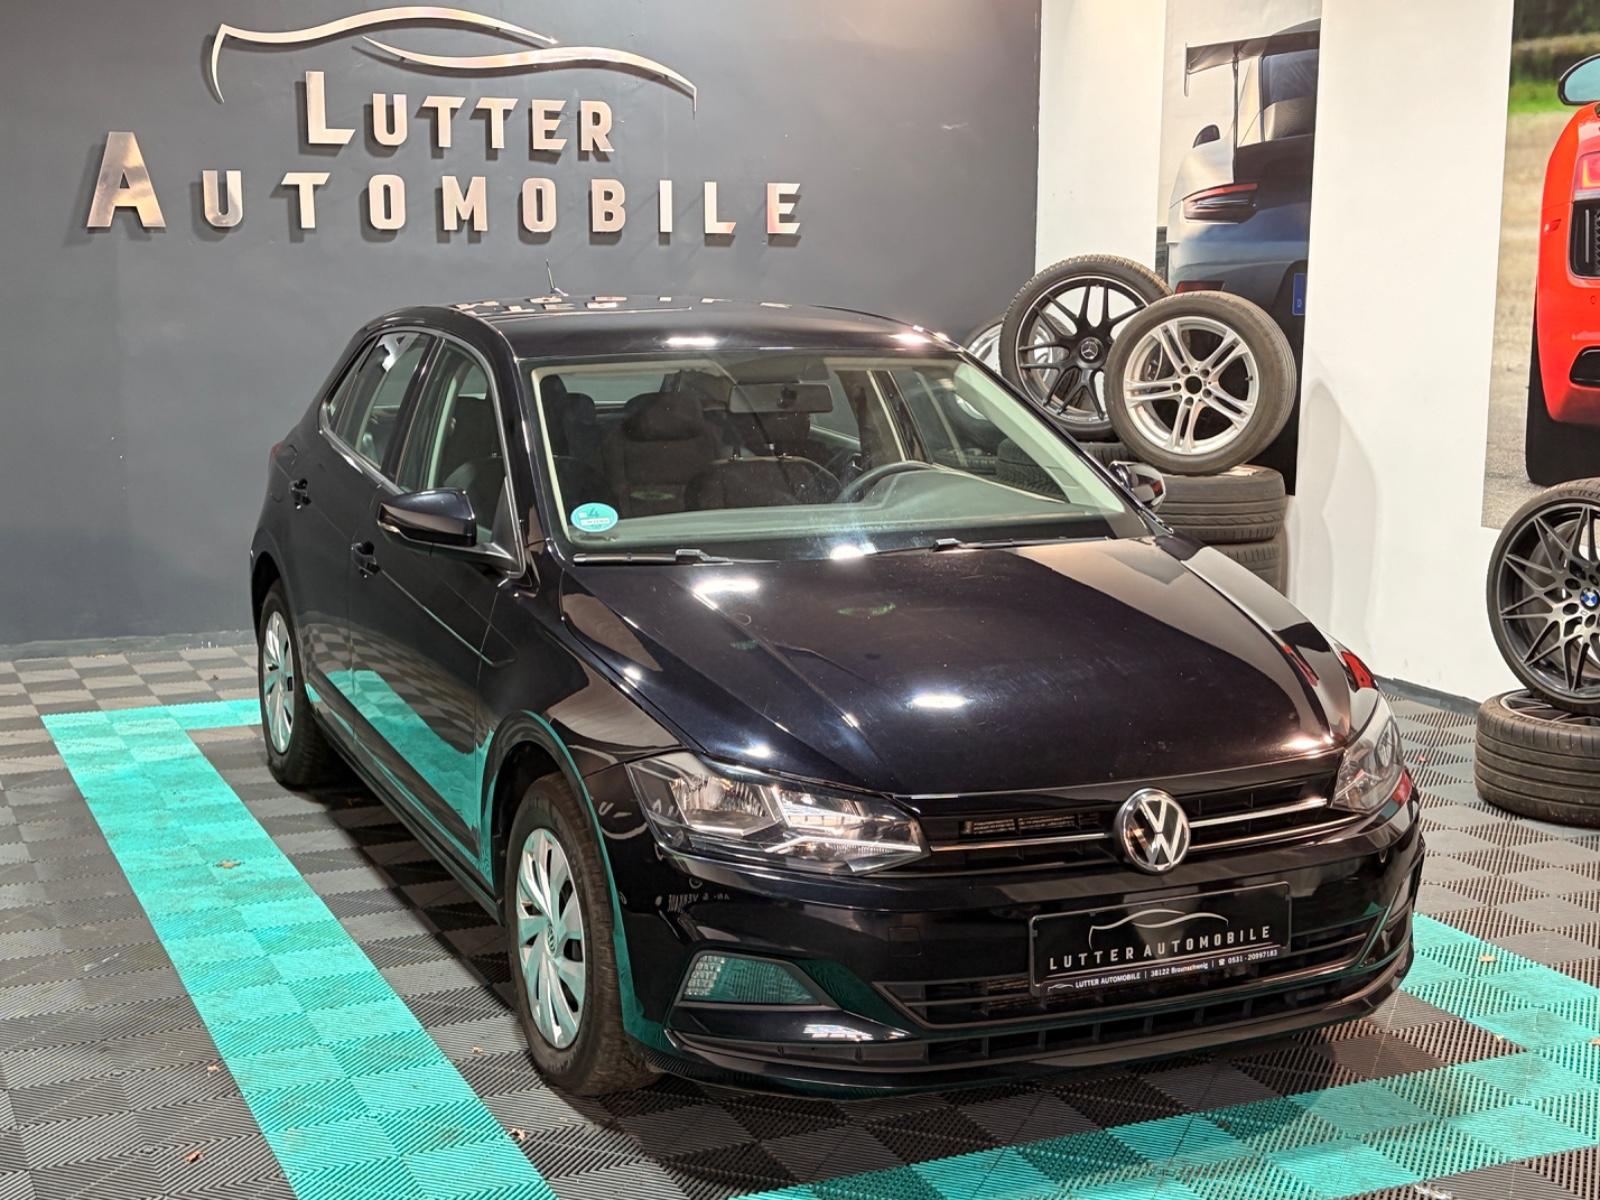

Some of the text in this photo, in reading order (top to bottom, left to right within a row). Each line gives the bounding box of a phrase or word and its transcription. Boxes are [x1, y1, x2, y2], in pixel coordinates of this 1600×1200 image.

[305, 71, 614, 153] LUTTER
[87, 131, 801, 236] AUTOMOBILE
[1049, 925, 1271, 971] LUTTER AUTOMOBILE
[1075, 978, 1100, 989] LUTTER
[1100, 972, 1141, 985] AUTOMOBILE
